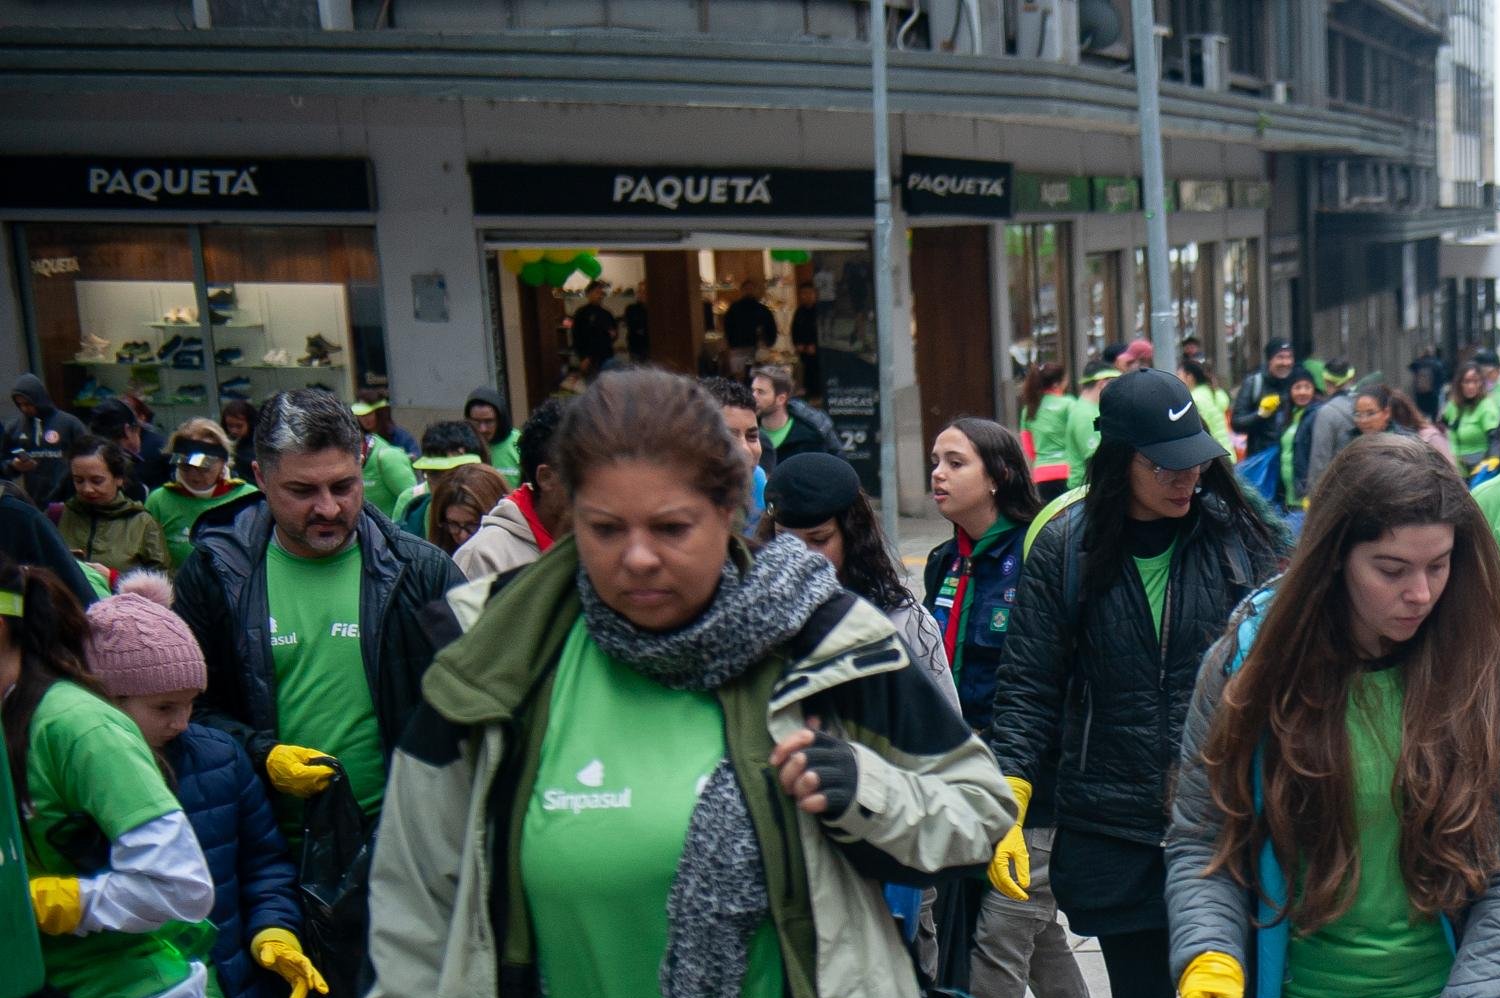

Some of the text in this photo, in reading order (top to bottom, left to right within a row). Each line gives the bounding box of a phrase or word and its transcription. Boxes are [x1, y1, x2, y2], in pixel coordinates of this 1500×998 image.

[88, 166, 259, 201] PAQUETÁ
[613, 174, 772, 210] PAQUETÁ
[907, 172, 1005, 198] PAQUETÁ
[542, 787, 632, 815] Sinpasul
